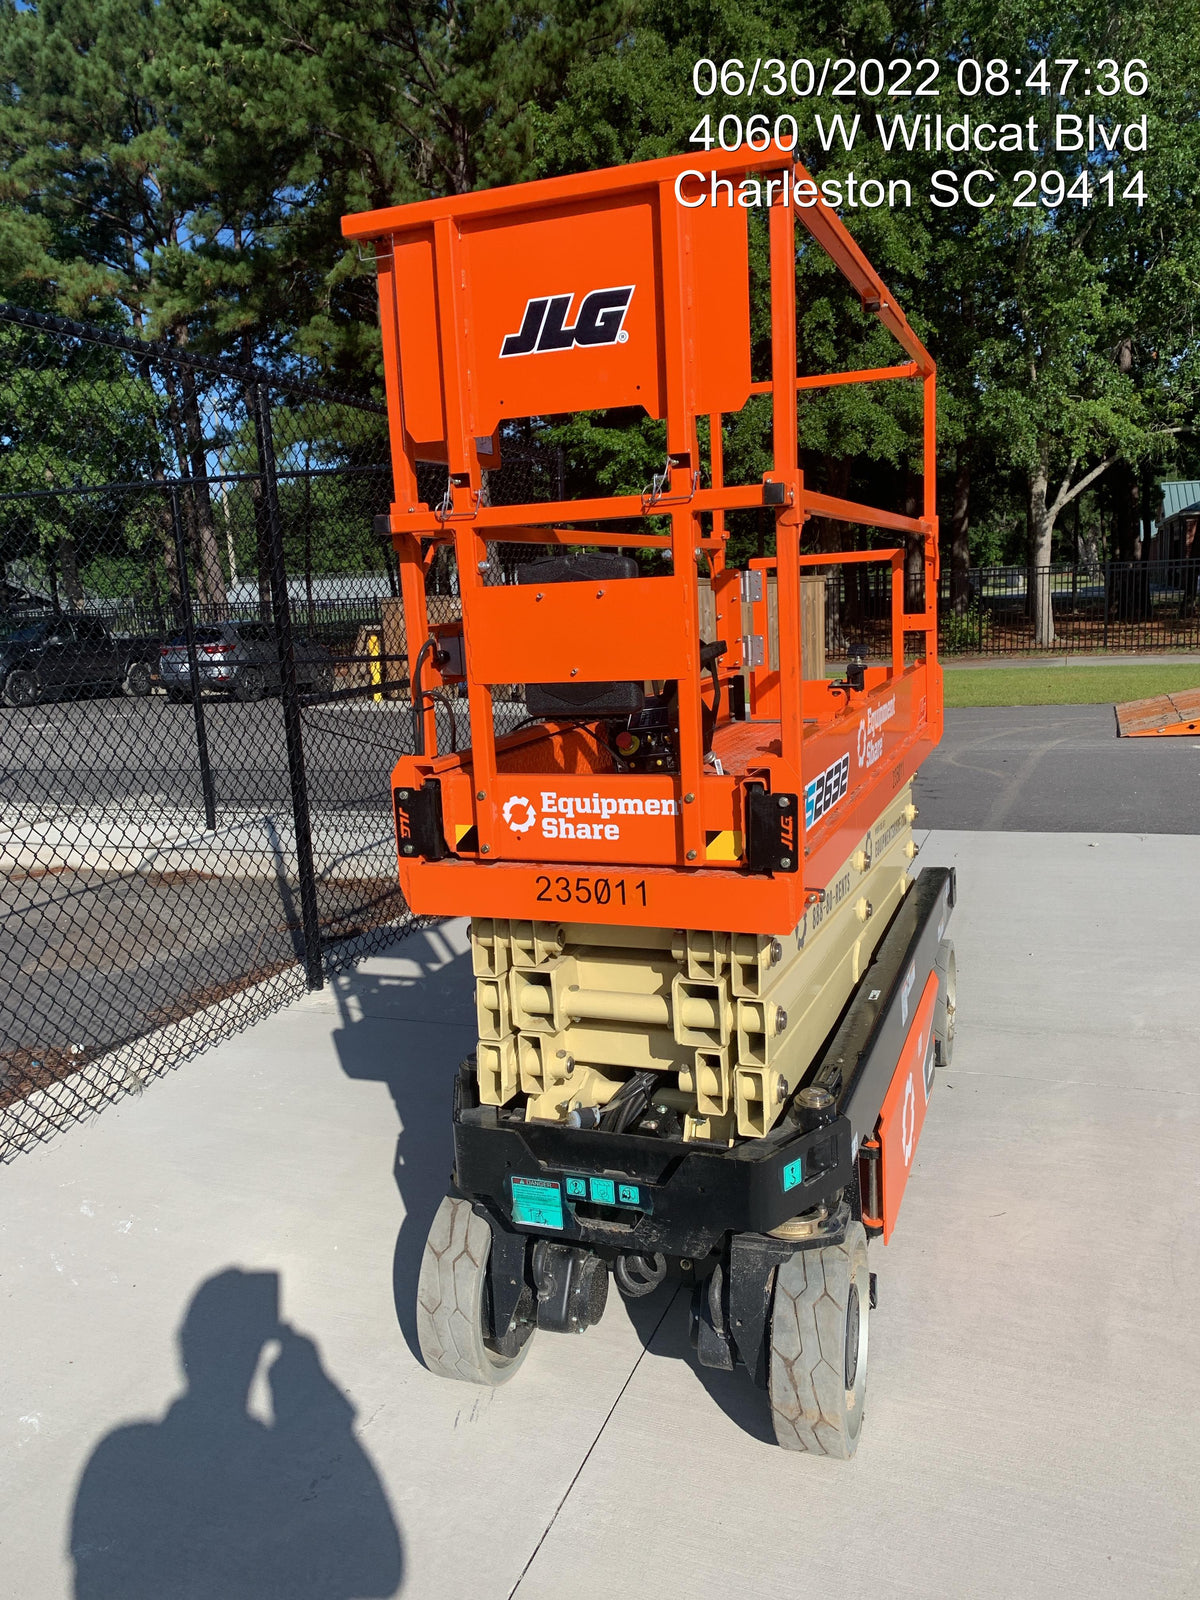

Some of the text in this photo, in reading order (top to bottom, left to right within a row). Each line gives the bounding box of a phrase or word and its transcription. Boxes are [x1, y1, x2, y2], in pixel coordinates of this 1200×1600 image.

[867, 693, 896, 738] Equipment
[866, 737, 884, 769] Share
[541, 791, 682, 819] Equipmen
[805, 753, 850, 831] S2632
[398, 807, 411, 839] JLG
[541, 817, 620, 842] Share
[780, 815, 794, 852] JLG
[526, 1178, 553, 1188] DANGER
